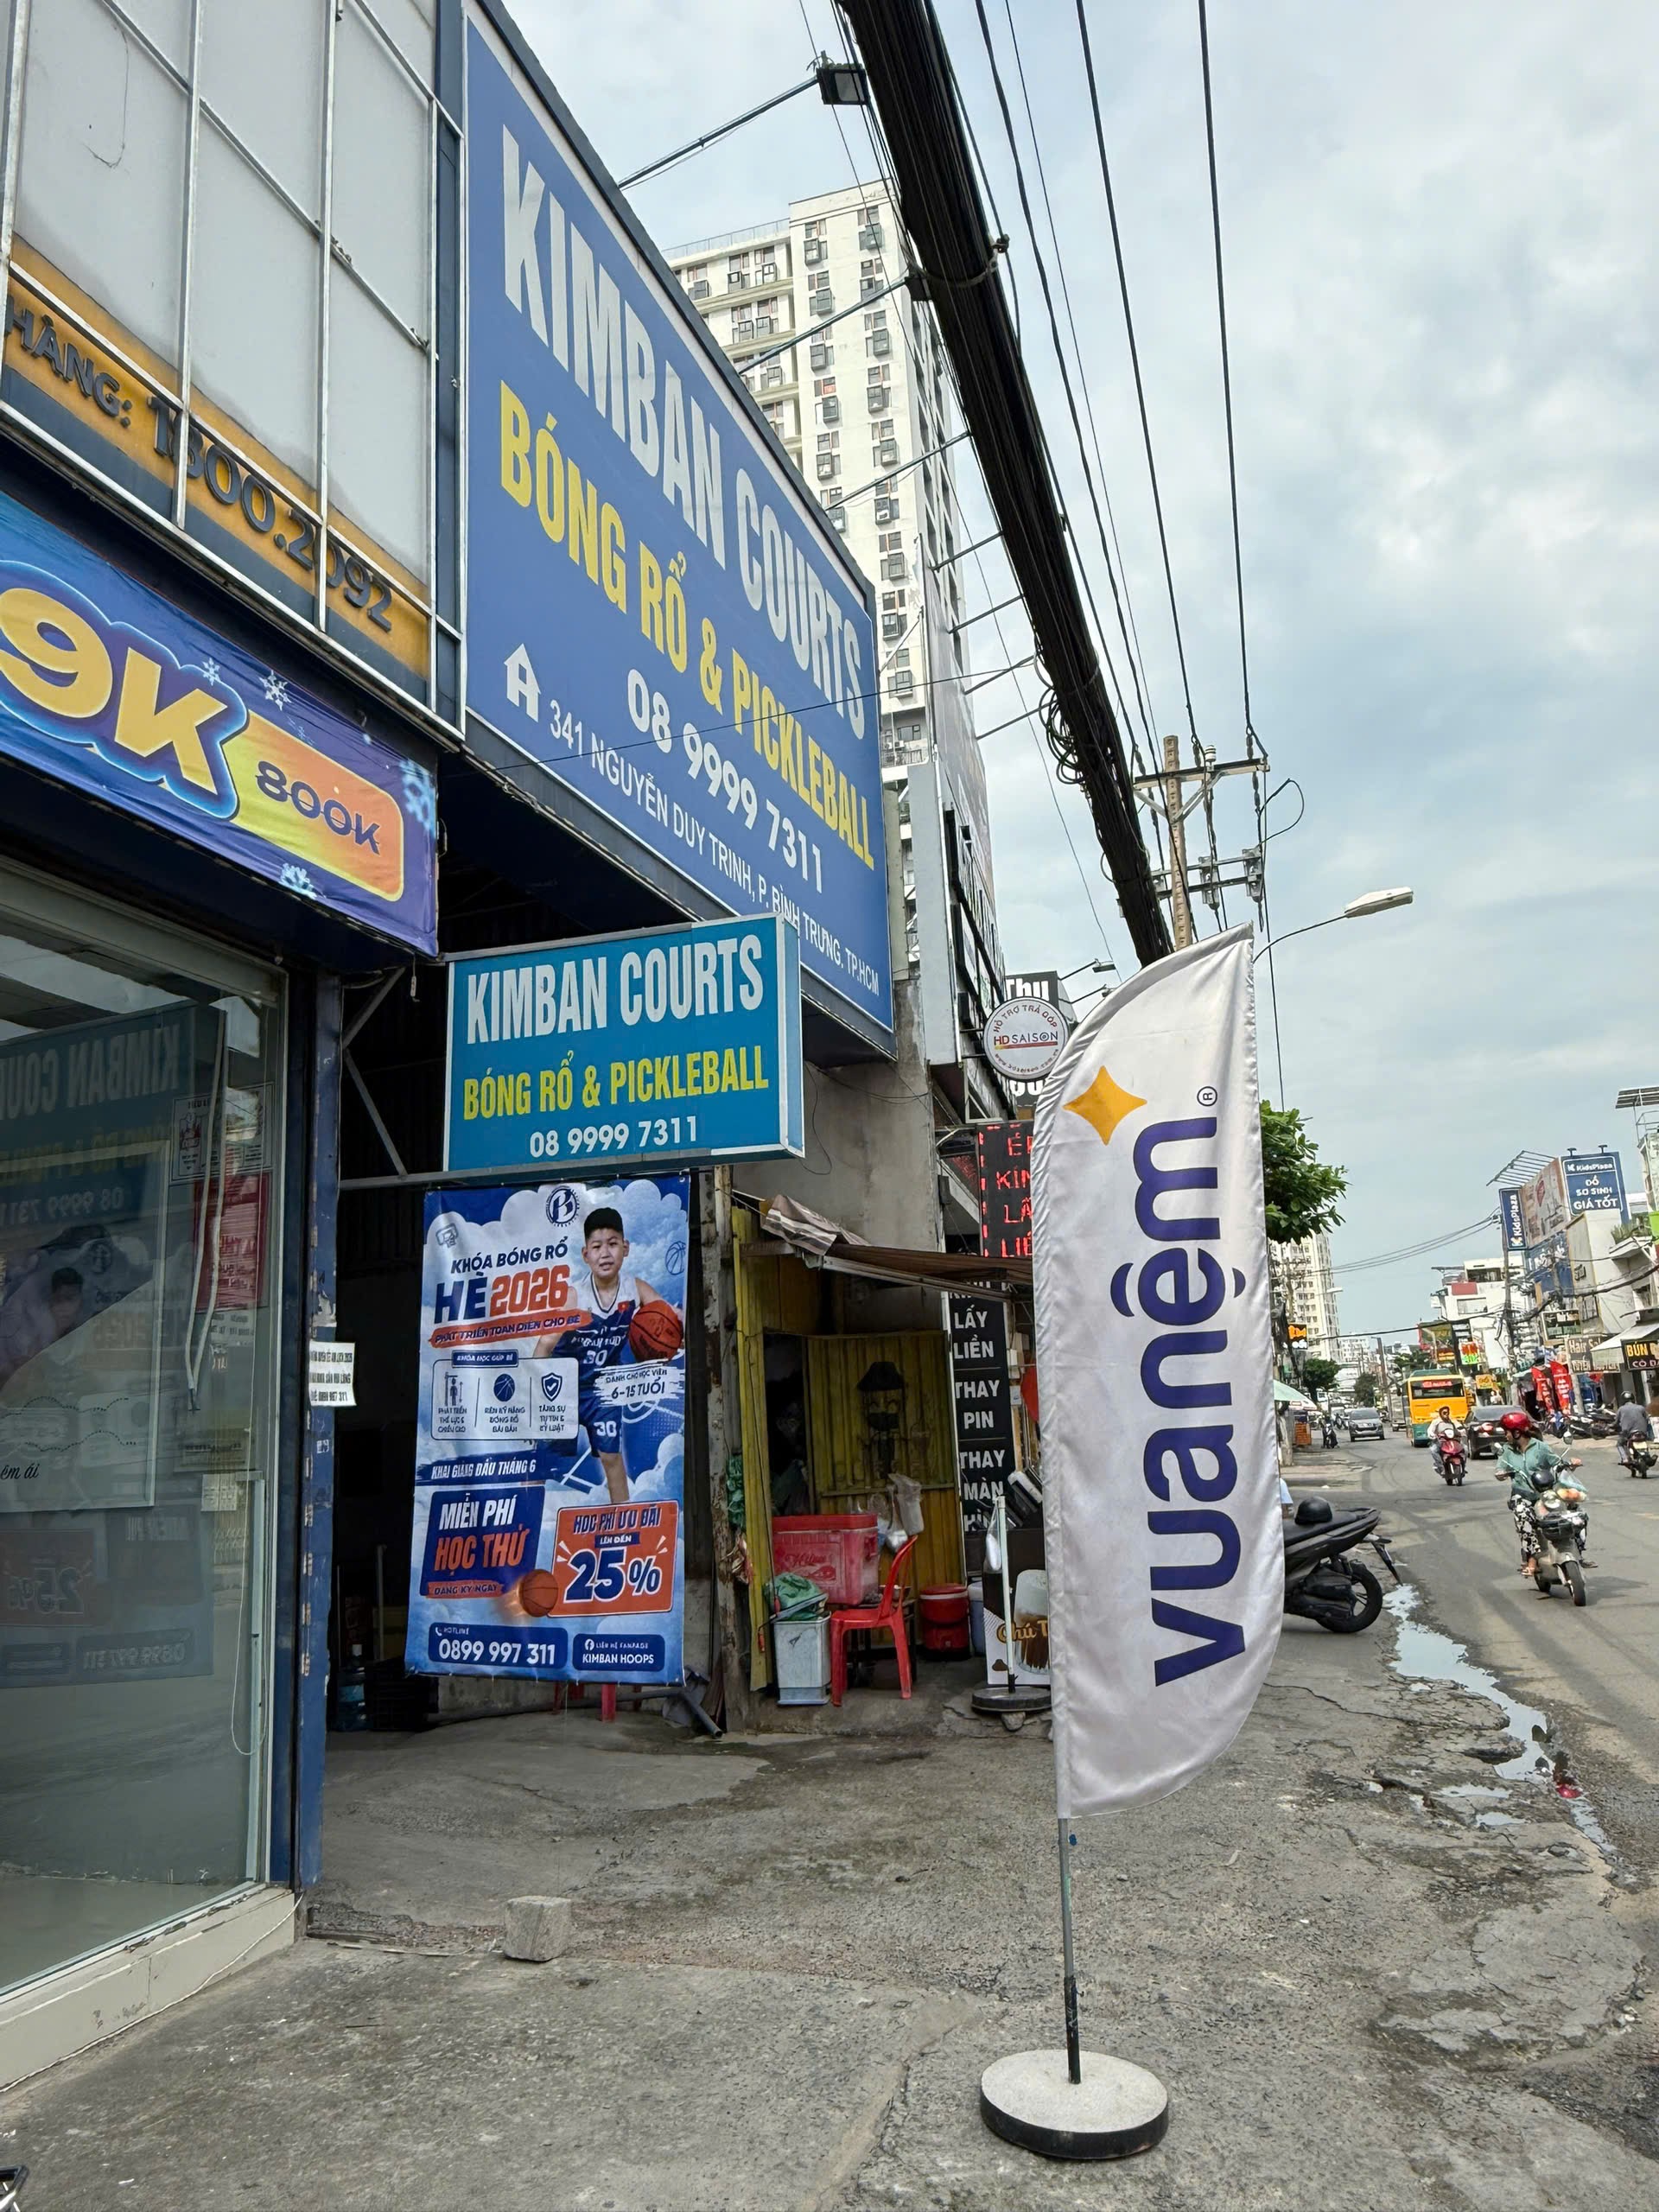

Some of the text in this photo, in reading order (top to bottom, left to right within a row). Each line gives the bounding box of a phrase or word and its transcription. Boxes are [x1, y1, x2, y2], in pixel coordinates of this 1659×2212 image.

[503, 124, 865, 741] KIMBAN COURTS
[501, 380, 874, 870] BÓNG RỔ & PICKLEBALL
[627, 669, 822, 893] 08 9999 7311
[257, 760, 382, 857] 800K
[550, 700, 582, 758] 341
[591, 733, 668, 827] NGUYỄN
[673, 802, 705, 855] DUY
[709, 832, 755, 902] TRINH,
[759, 874, 769, 908] P.
[845, 948, 880, 995] TP.HCM
[467, 934, 764, 1044] KIMBAN COURTS
[463, 1046, 769, 1120] BÓNG RỔ & PICKLEBALL
[530, 1116, 696, 1158] 08 9999 7311
[1573, 1198, 1594, 1210] GIÁ
[451, 1236, 569, 1274] KHÓA BÓNG RỔ
[434, 1264, 570, 1324] HÈ 2026
[543, 1317, 565, 1328] CHO
[954, 1304, 988, 1329] LẤY
[953, 1334, 994, 1359] LIỀN
[1626, 1341, 1648, 1357] BÚN
[611, 1376, 665, 1400] 6-15 TUỔI
[955, 1380, 1000, 1399] THAY
[594, 1421, 617, 1437] 30
[963, 1411, 994, 1429] PIN
[431, 1465, 450, 1479] KHAI
[498, 1458, 527, 1475] THÁNG
[529, 1459, 537, 1473] 6
[960, 1450, 1005, 1469] THAY
[964, 1477, 1004, 1501] MÀN
[439, 1493, 518, 1530] MIỄN PHÍ
[434, 1523, 531, 1576] HỌC THỬ
[613, 1534, 632, 1544] ĐẾN
[563, 1547, 663, 1603] 25%
[474, 1583, 498, 1593] NGAY
[438, 1638, 555, 1665] 0899 997 311
[582, 1653, 654, 1664] KIMBAN HOOPS
